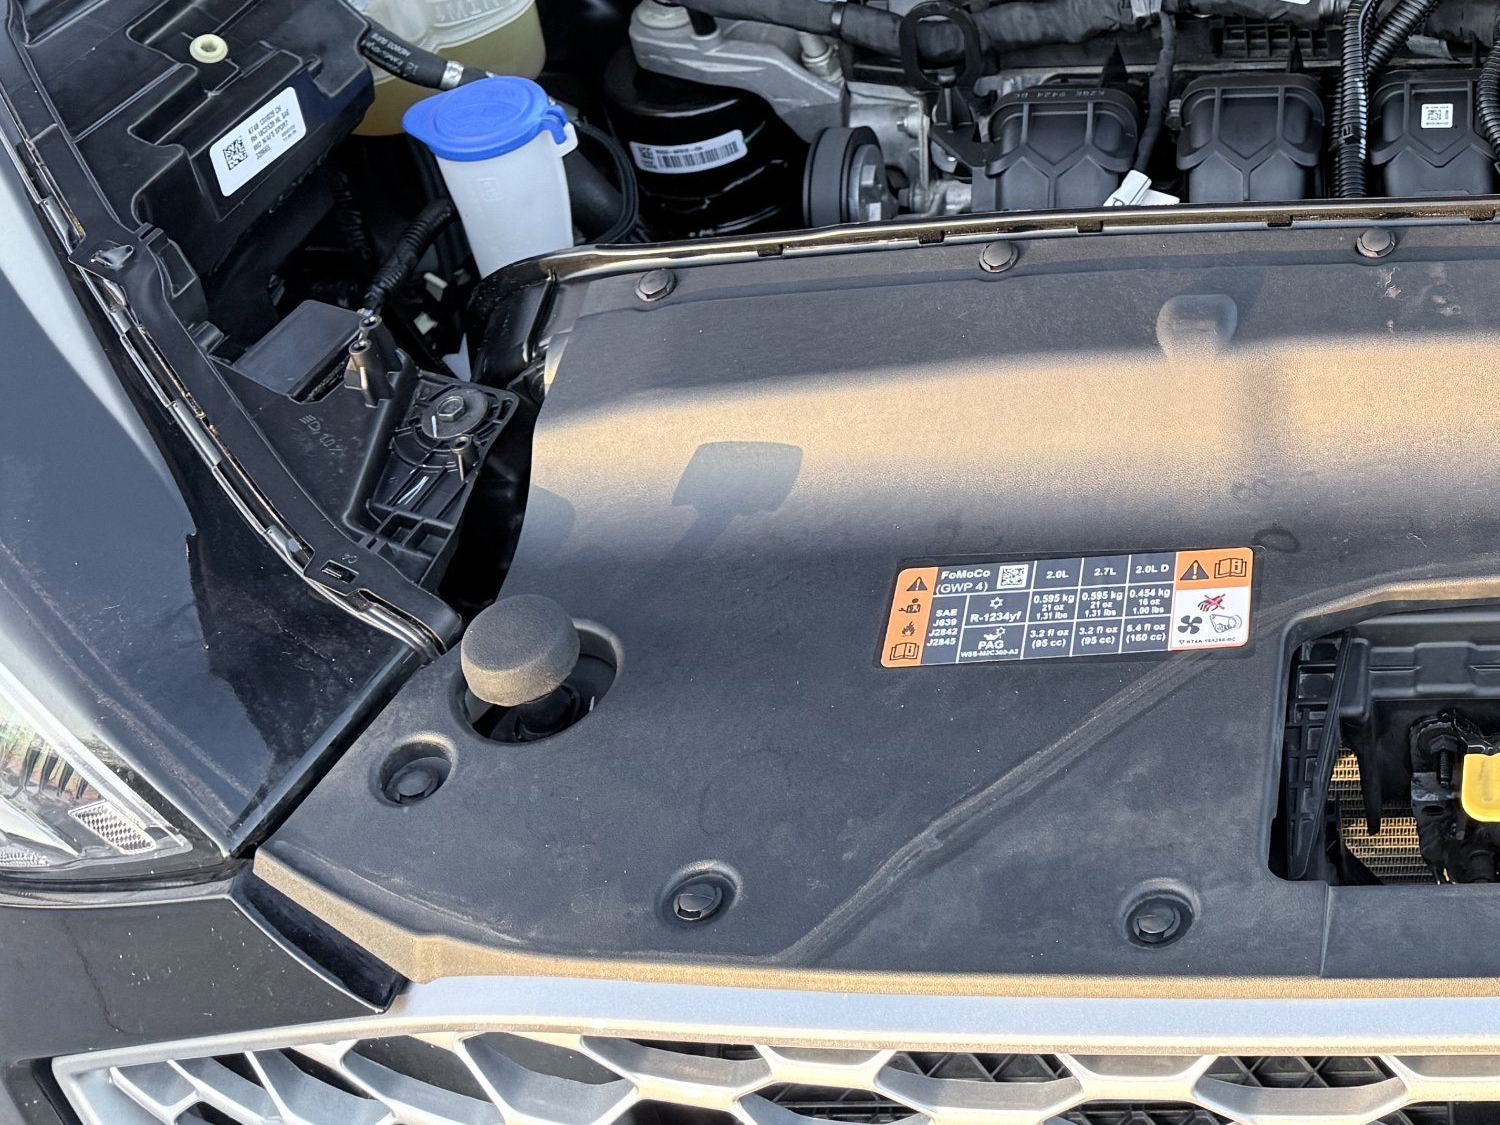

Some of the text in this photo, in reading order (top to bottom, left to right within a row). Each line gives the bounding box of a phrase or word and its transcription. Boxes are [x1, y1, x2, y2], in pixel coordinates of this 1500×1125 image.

[1094, 567, 1116, 576] 2.7L
[1135, 564, 1169, 574] 2.0L D
[941, 569, 991, 580] FoMoCo
[1046, 570, 1069, 579] 2.0L
[935, 581, 988, 595] (GWP 4)
[1081, 591, 1123, 601] 0.595 kg
[1129, 588, 1170, 598] 0.454 kg
[1033, 594, 1075, 604] 0.595 kg
[1090, 601, 1100, 609] 21
[936, 609, 958, 617] SAE
[1085, 609, 1101, 617] 1.31
[1133, 606, 1164, 615] 1.00 lbs
[970, 611, 1022, 623] R-1234yf
[1036, 611, 1068, 620] 1.31 lbs
[932, 618, 957, 627] J639
[1079, 626, 1094, 635] 3.2
[1096, 626, 1103, 634] fl
[1126, 624, 1141, 632] 5.4
[1144, 623, 1151, 631] fl
[928, 628, 958, 637] J2842
[1030, 629, 1045, 638] 3.2
[1047, 629, 1054, 637] fl
[1150, 632, 1166, 642] cc)
[926, 638, 956, 646] J2845
[978, 640, 1004, 650] PAG
[1031, 638, 1066, 649] (95 cc)
[1081, 635, 1115, 646] (95 cc)
